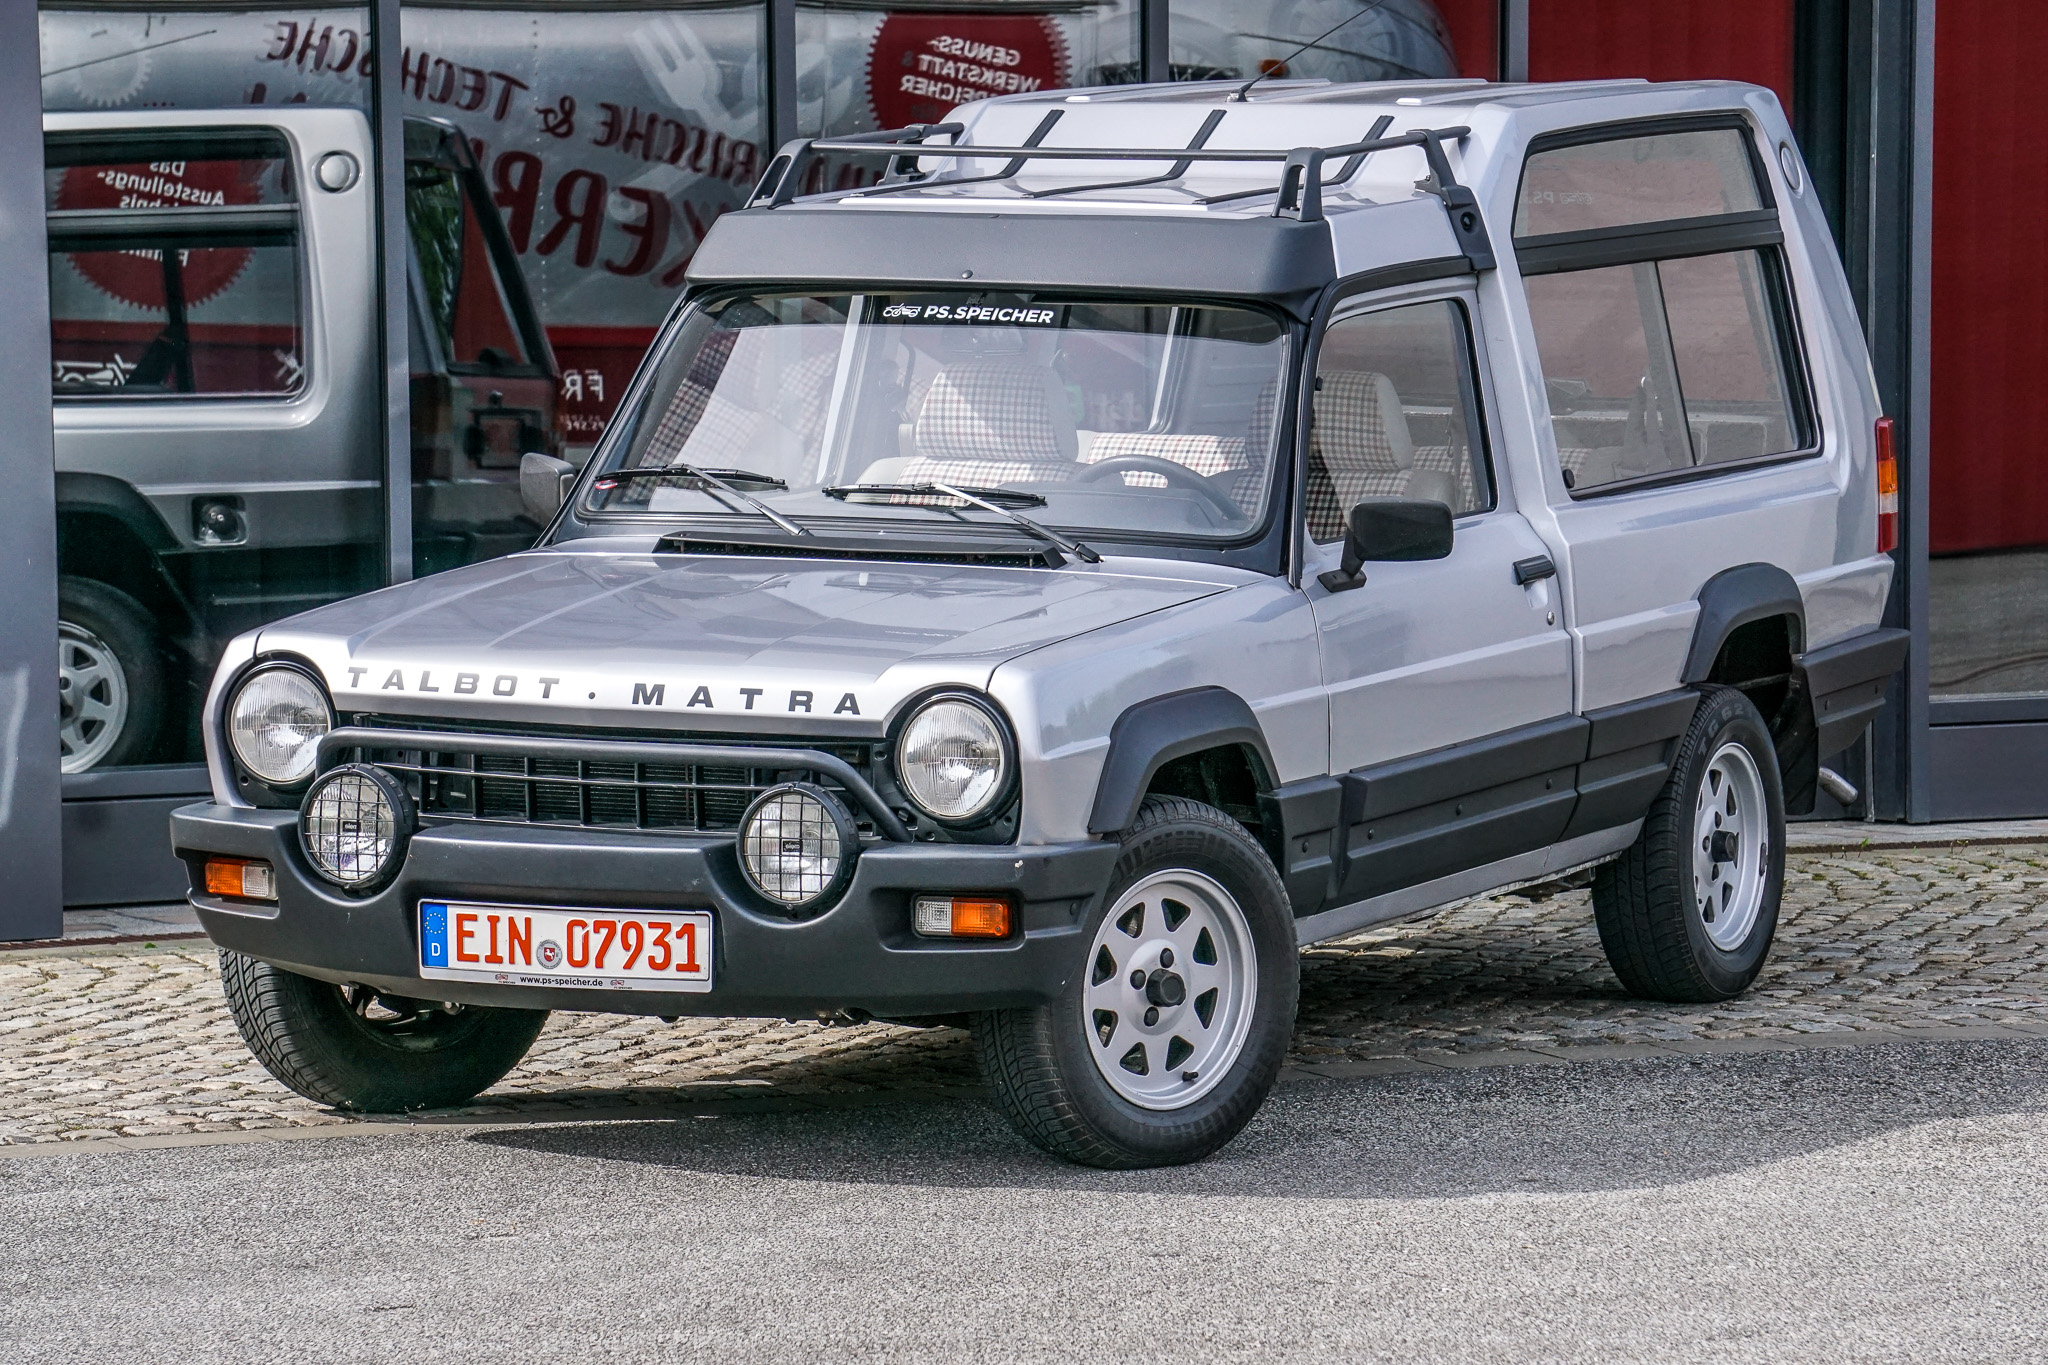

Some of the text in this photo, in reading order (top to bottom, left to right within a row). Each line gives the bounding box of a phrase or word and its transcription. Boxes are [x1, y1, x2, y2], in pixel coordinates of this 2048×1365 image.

[924, 304, 1054, 324] PS.SPEICHER
[347, 666, 861, 715] TALBOT MATRA
[431, 943, 441, 957] D
[456, 913, 531, 965] EIN
[566, 919, 700, 973] 07931
[520, 976, 603, 987] www.ps-speicher.de
